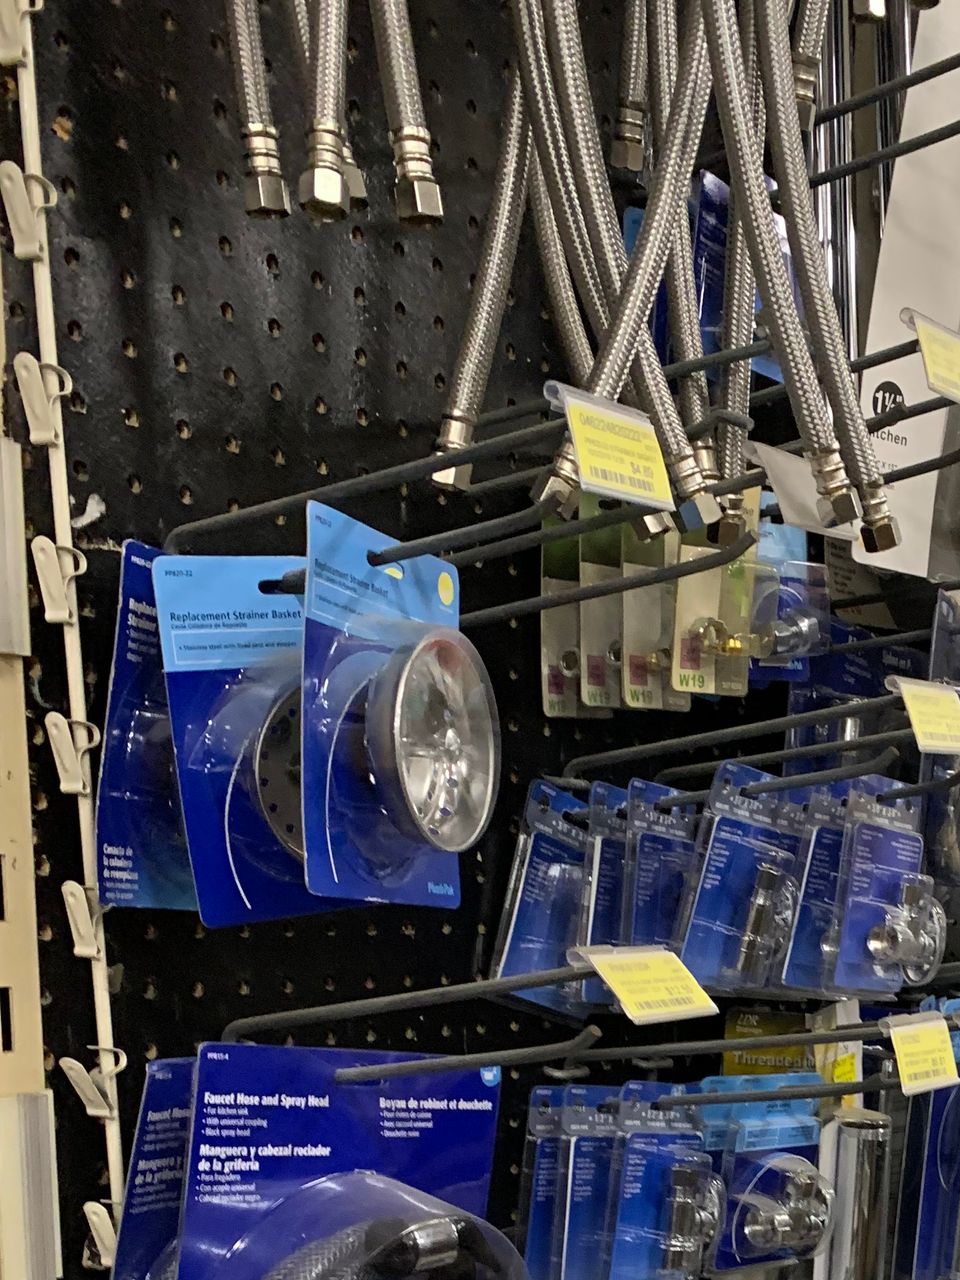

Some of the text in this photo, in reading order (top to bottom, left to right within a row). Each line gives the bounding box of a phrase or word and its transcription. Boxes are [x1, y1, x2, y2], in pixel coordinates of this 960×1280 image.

[169, 609, 301, 623] Replacement Strainer Basket
[679, 673, 705, 688] W19
[204, 1092, 330, 1110] Faucet Hose and Spray Head
[379, 1096, 493, 1111] Boyau de robinet et douchette
[199, 1144, 332, 1161] Manguera y cabezal rociador
[197, 1158, 211, 1172] de
[212, 1158, 222, 1172] la
